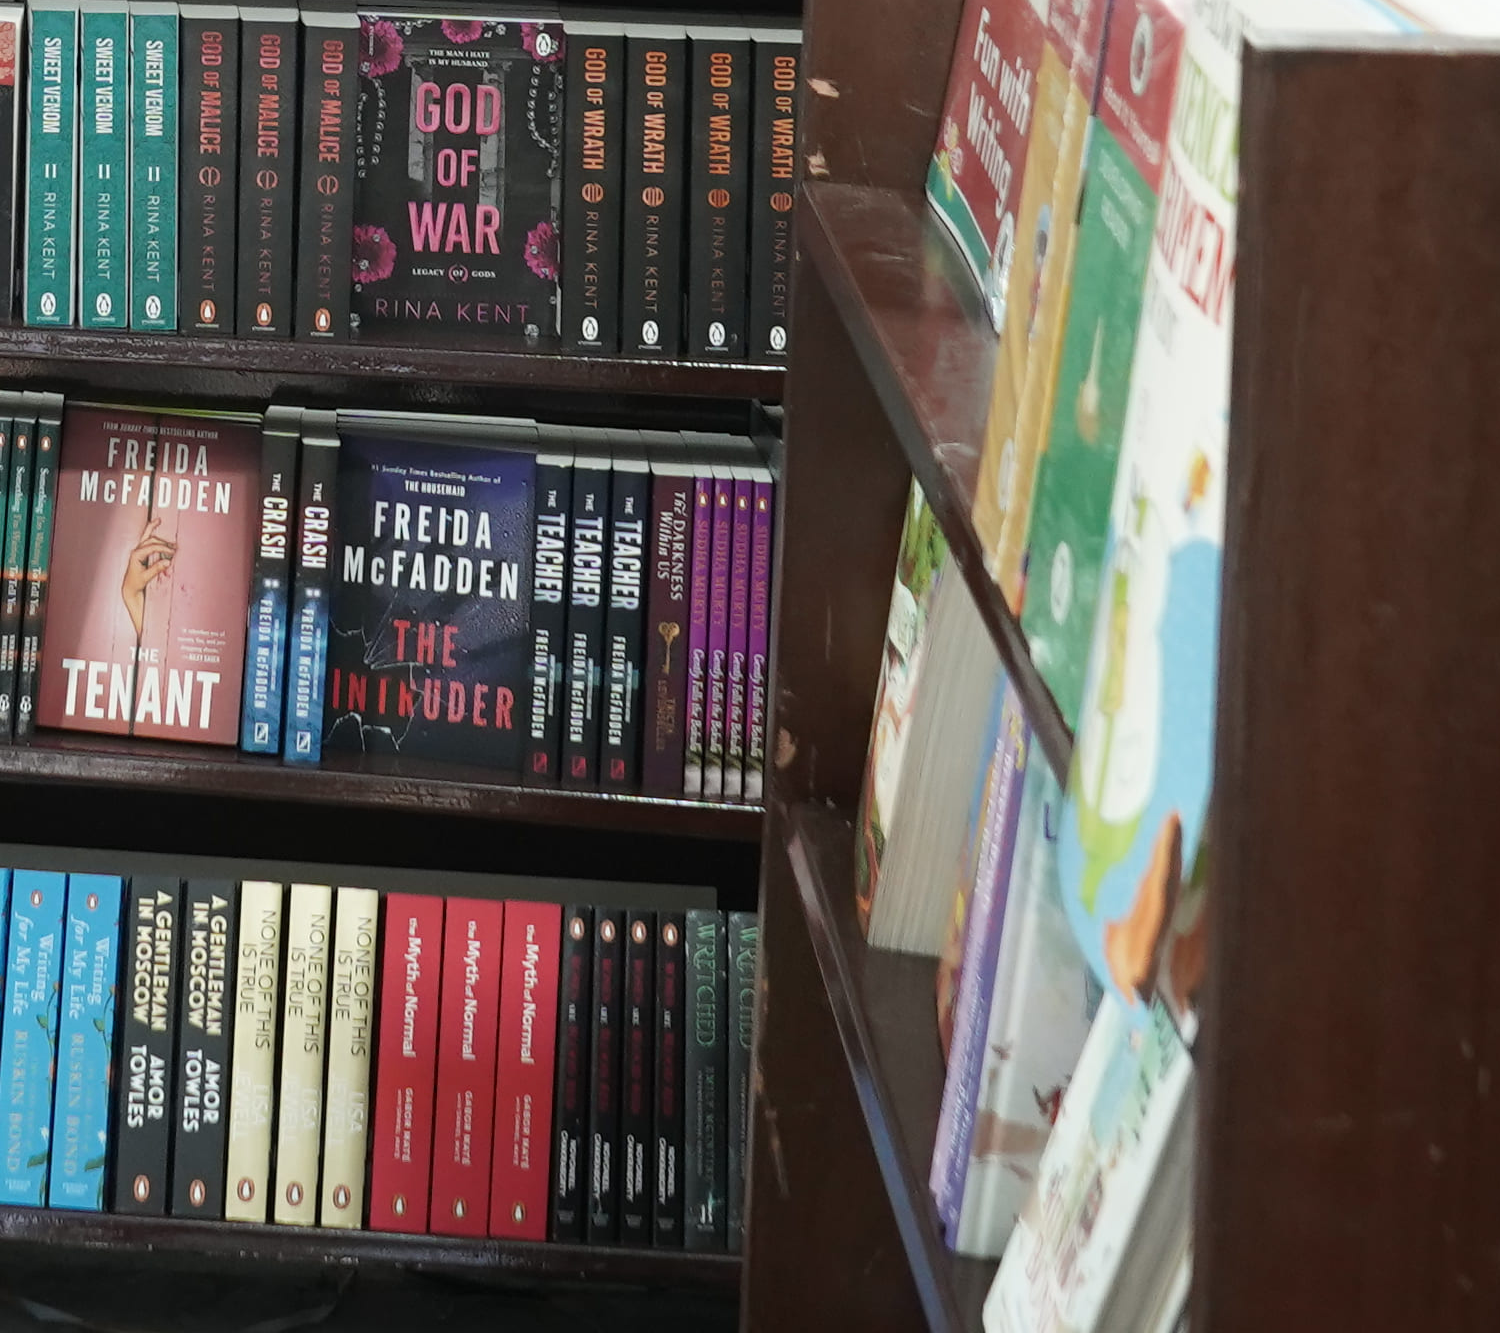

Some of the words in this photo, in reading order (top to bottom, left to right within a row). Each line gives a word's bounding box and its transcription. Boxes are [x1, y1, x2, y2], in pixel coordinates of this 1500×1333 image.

[44, 37, 62, 83] SWEET
[973, 5, 1001, 90] Fun
[1000, 55, 1032, 139] with
[42, 87, 61, 134] VENOM
[415, 81, 502, 135] GOD
[436, 148, 478, 187] OF
[967, 87, 1014, 219] Writing
[408, 202, 501, 256] WAR
[374, 501, 492, 549] FREIDA
[344, 546, 519, 601] McFADDEN
[61, 656, 222, 733] TENANT
[128, 1044, 148, 1128] TOWLES
[147, 1054, 166, 1120] AMOR
